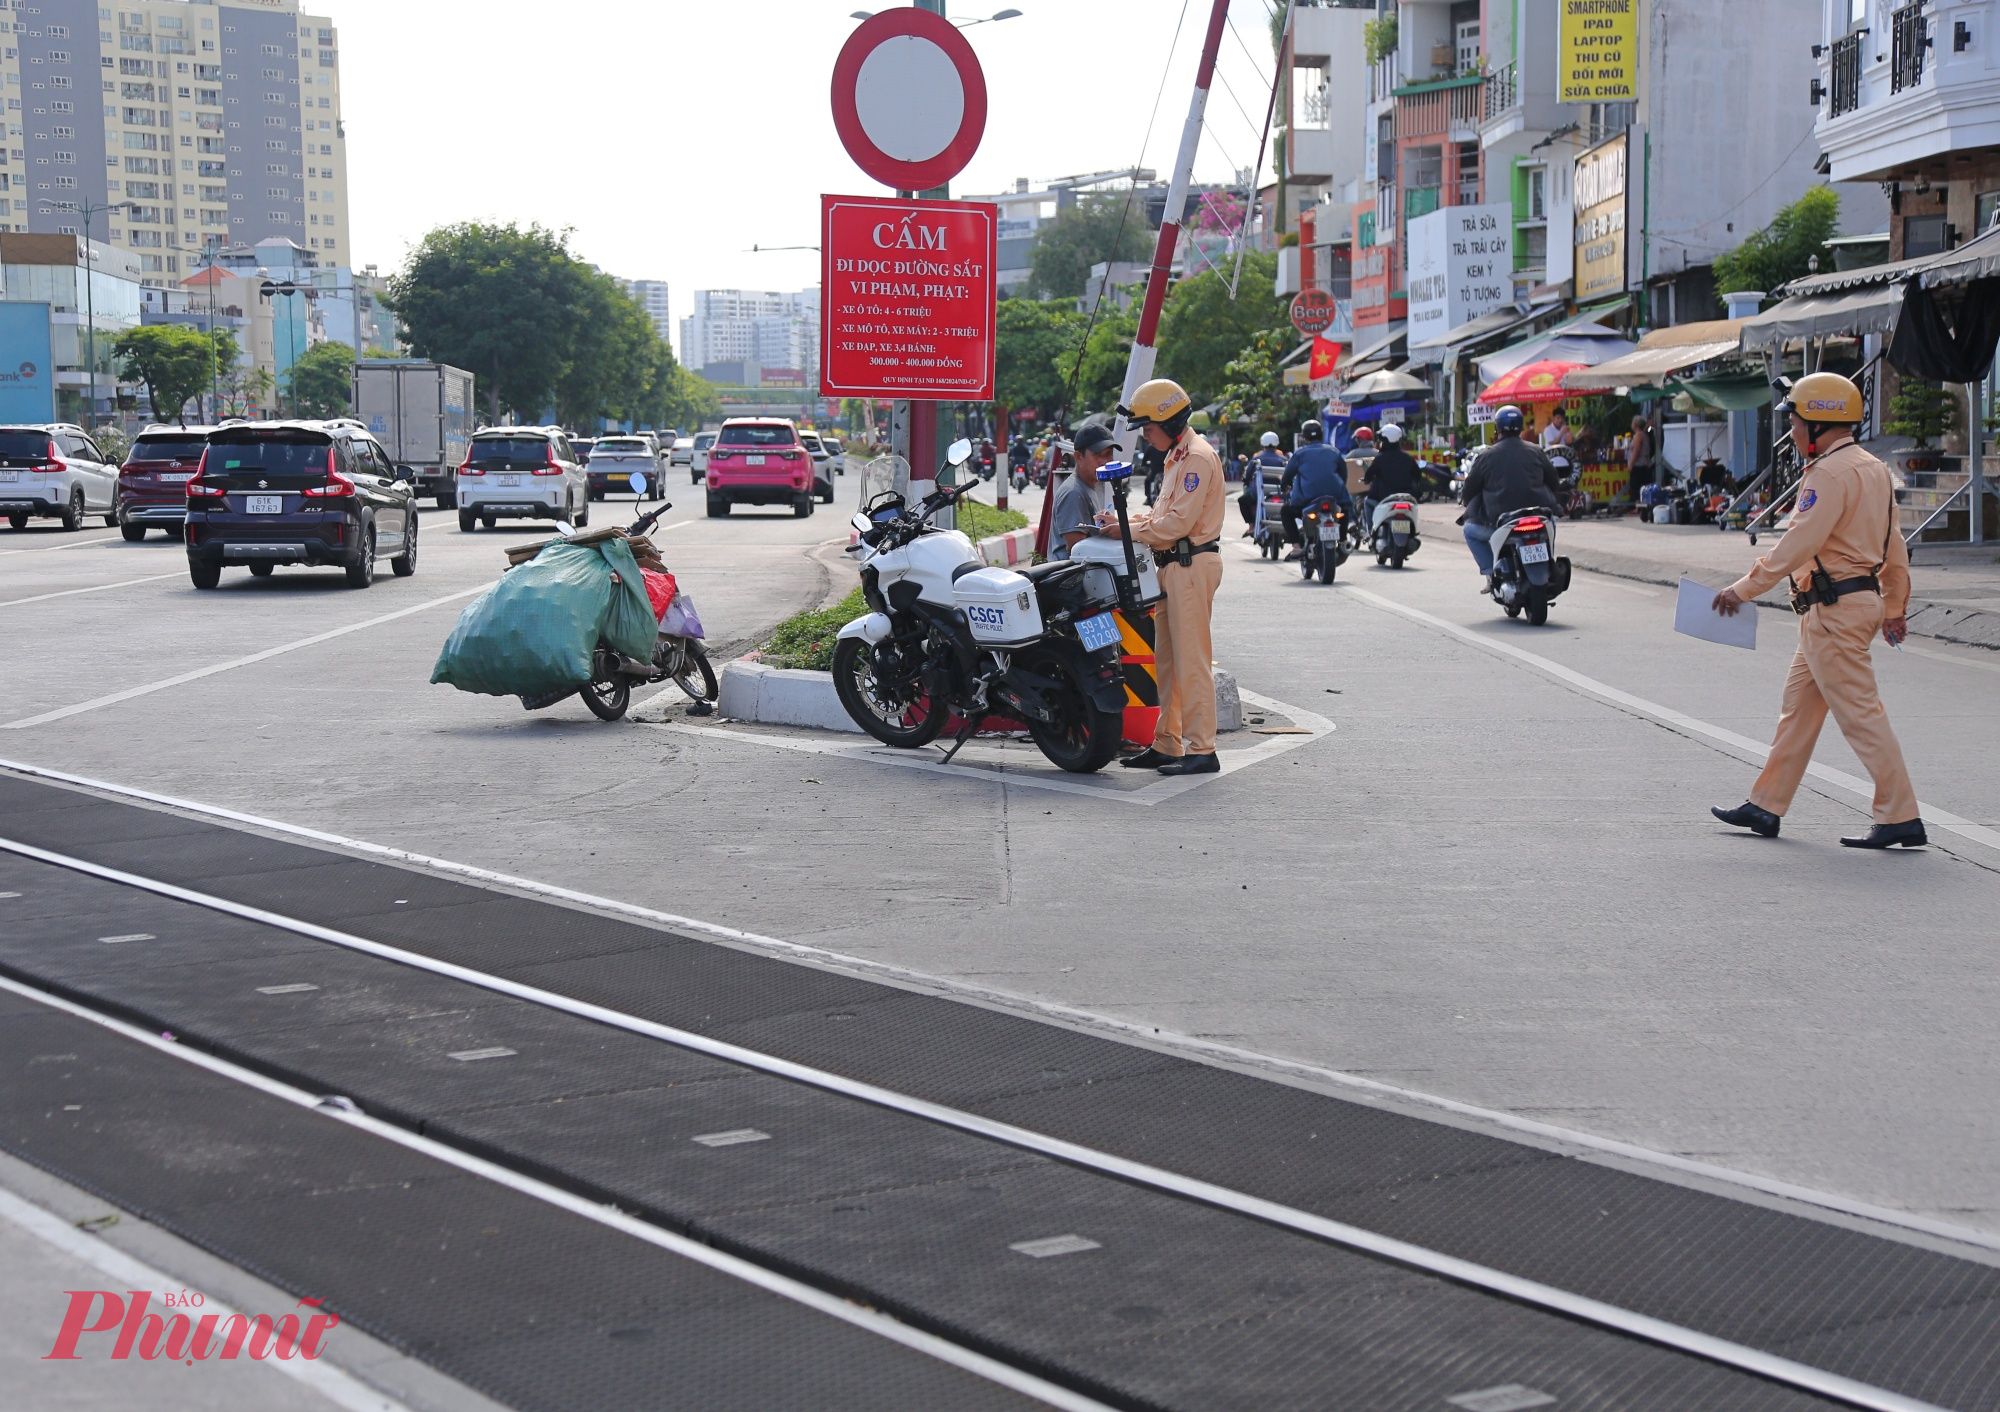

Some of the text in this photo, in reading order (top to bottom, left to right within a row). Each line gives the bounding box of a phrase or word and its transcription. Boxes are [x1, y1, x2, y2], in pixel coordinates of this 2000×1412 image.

[1568, 0, 1630, 15] SMARTPHONE
[1584, 19, 1613, 29] IPAD
[1574, 35, 1622, 46] LAPTOP
[1576, 50, 1621, 63] THU CŨ
[1572, 66, 1624, 80] ĐỔI MỚI
[1565, 82, 1630, 97] SỬA CHỮA
[1462, 214, 1497, 232] TRÀ SỮA
[872, 212, 948, 251] CẤM
[1453, 236, 1507, 256] TRÀ TRÁI CÂY
[836, 258, 983, 278] ĐI DỌC ĐƯỜNG SẮT
[1467, 260, 1493, 278] KEM Ý
[850, 281, 969, 301] VI PHẠM, PHẠT:
[1474, 286, 1501, 304] TƯỢNG
[842, 305, 855, 314] XE
[857, 304, 865, 315] Ô
[866, 304, 883, 315] TÔ:
[884, 307, 890, 315] 4
[896, 307, 902, 315] 6
[903, 305, 932, 319] TRIỆU
[1293, 305, 1333, 319] Beer
[842, 324, 855, 333] XE
[857, 322, 873, 334] MÔ
[874, 323, 891, 336] TÔ,
[892, 326, 905, 335] XE
[906, 324, 931, 336] MÁY:
[932, 327, 938, 336] 2
[944, 327, 950, 336] 3
[951, 326, 979, 339] TRIỆU
[842, 342, 855, 351] XE
[856, 342, 878, 353] ĐẠP,
[880, 343, 893, 352] XE
[894, 344, 906, 353] 3,4
[907, 342, 936, 353] BÁNH:
[869, 357, 899, 366] 300.000
[905, 358, 935, 367] 400.000
[936, 355, 963, 368] ĐỒNG
[883, 376, 897, 384] QUY
[1157, 391, 1183, 414] CSGT
[1807, 399, 1847, 411] CSGT
[1468, 406, 1485, 415] CAM
[1473, 415, 1492, 423] 10K
[256, 497, 272, 505] 61K
[251, 505, 278, 513] 167.63
[974, 622, 1004, 632] TRAFFIC POLICE
[1081, 614, 1111, 635] 59-A1
[1085, 628, 1120, 650] 012.90
